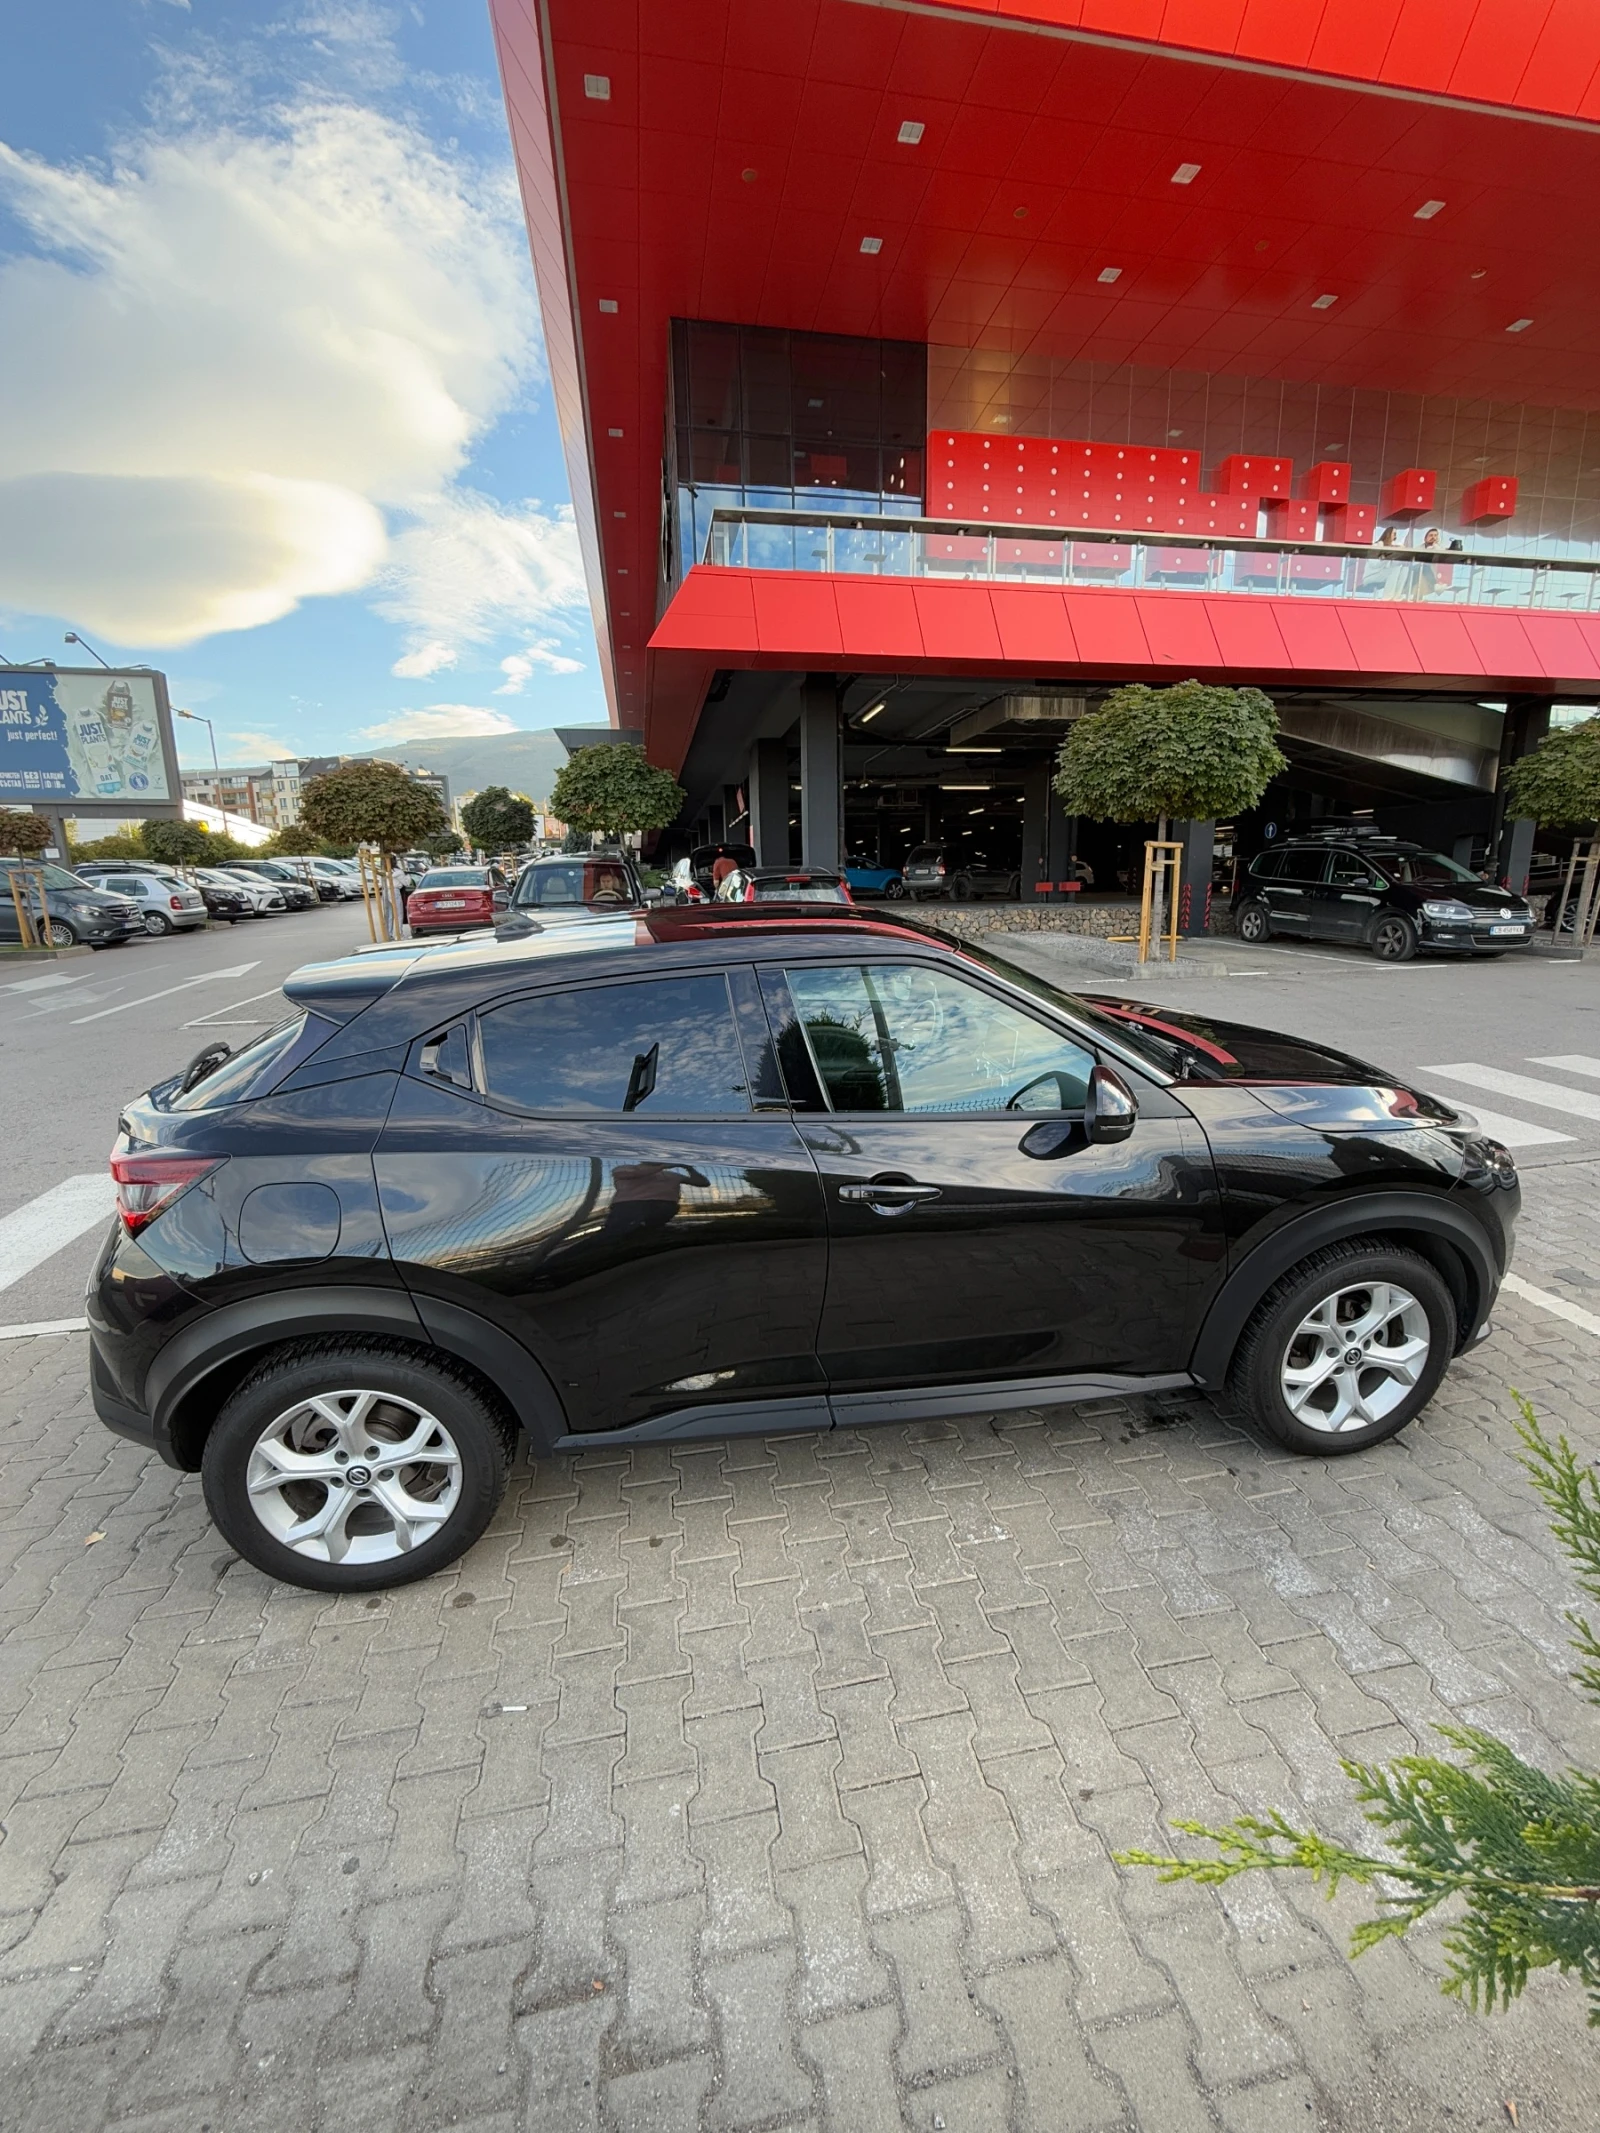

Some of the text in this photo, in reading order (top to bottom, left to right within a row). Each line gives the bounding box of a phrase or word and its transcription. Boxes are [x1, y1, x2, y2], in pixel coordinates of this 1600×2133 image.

[0, 690, 27, 711] UST
[7, 729, 58, 742] just perfect!
[80, 722, 103, 736] JUST
[81, 734, 107, 744] PLANTS
[134, 733, 151, 746] JUST
[24, 771, 39, 780] БЕЗ
[100, 774, 113, 782] OAT
